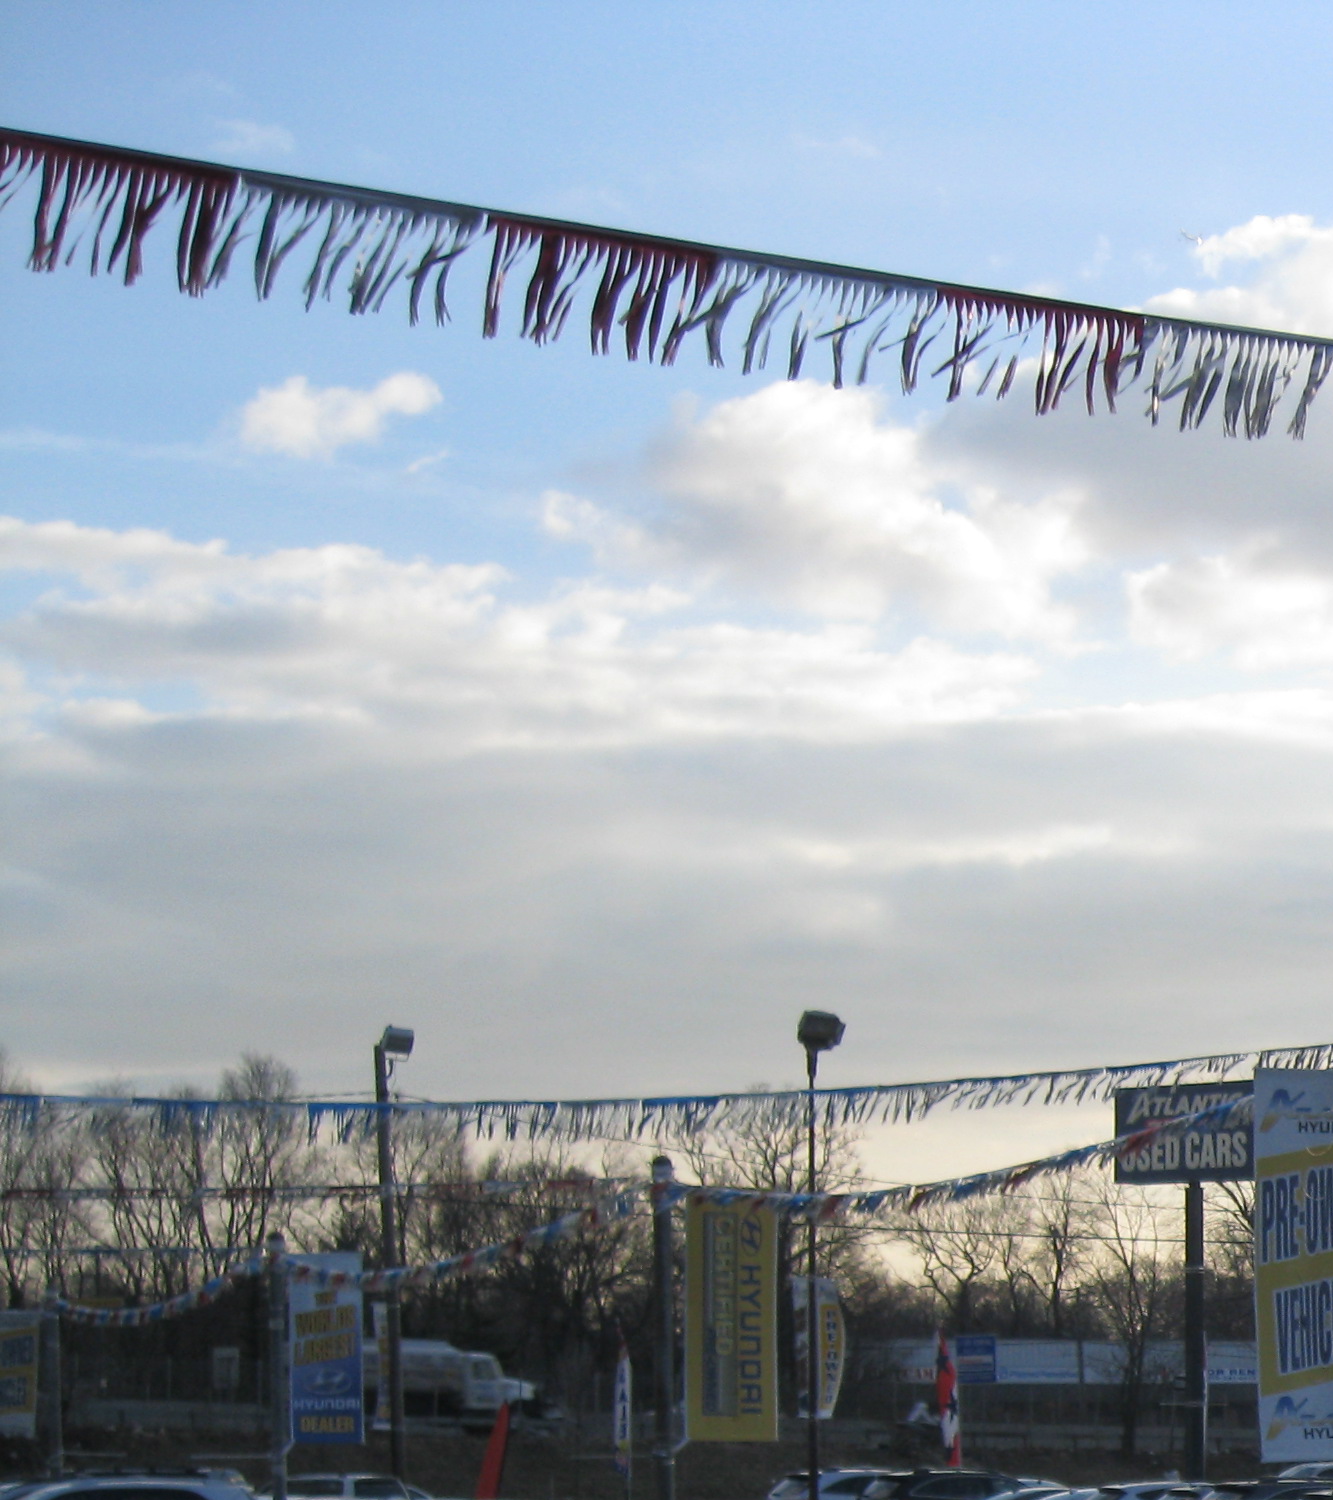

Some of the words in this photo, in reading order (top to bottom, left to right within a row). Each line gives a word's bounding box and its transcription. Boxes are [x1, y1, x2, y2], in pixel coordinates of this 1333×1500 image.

[1120, 1133, 1180, 1173] USED
[1185, 1131, 1248, 1170] CARS
[740, 1264, 762, 1415] HYUNDAI
[294, 1399, 362, 1411] HYUNDAI
[300, 1416, 355, 1433] DEALER
